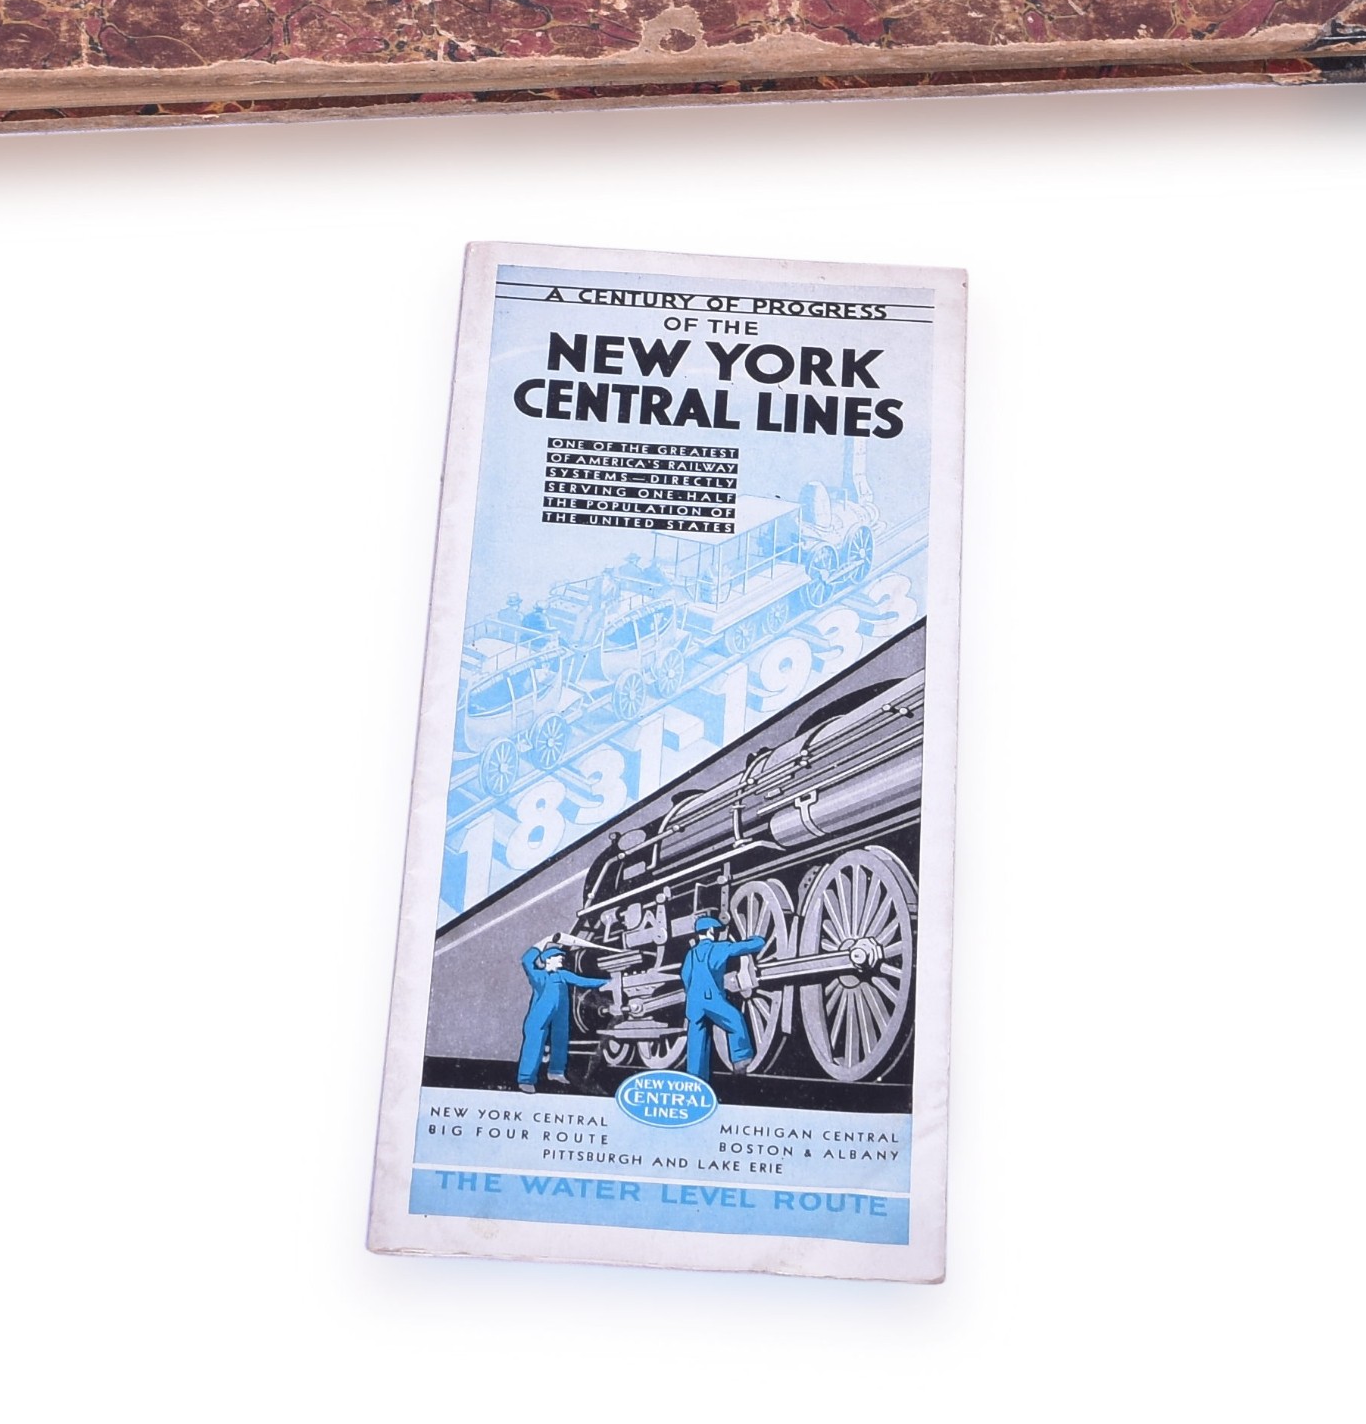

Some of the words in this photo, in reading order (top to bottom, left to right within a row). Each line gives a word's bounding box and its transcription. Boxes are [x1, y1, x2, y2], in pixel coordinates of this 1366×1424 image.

[545, 286, 567, 304] A
[576, 287, 695, 311] CENTURY
[705, 294, 739, 313] OF
[751, 297, 889, 321] PROGRESS
[662, 315, 699, 332] OF
[706, 317, 759, 336] THE
[546, 330, 692, 378] NEW
[703, 340, 885, 389] YORK
[512, 377, 741, 430] CENTRAL
[755, 390, 904, 439] LINES
[550, 437, 586, 451] ONE
[592, 440, 614, 452] OF
[619, 441, 649, 454] THE
[655, 443, 737, 460] GREATEST
[549, 452, 571, 465] OF
[571, 453, 661, 470] AMERICA'S
[666, 459, 736, 474] RAILWAY
[546, 482, 628, 498] SERVING
[544, 496, 579, 509] THE
[584, 498, 703, 517] POPULATION
[709, 506, 734, 518] OF
[543, 511, 578, 524] THE
[587, 514, 655, 529] UNITED
[664, 518, 732, 533] STATES
[634, 1078, 665, 1090] NEW
[667, 1080, 702, 1093] YORK
[623, 1087, 712, 1108] CENTRAL
[429, 1105, 469, 1118] NEW
[476, 1108, 522, 1122] YORK
[532, 1111, 608, 1127] CENTRAL
[644, 1106, 689, 1120] LINES
[427, 1123, 463, 1137] BIG
[475, 1125, 529, 1140] FOUR
[541, 1129, 608, 1145] ROUTE
[718, 1123, 812, 1140] MICHIGAN
[821, 1129, 899, 1144] CENTRAL
[542, 1147, 642, 1165] PITTSBURGH
[651, 1156, 688, 1169] AND
[696, 1158, 740, 1172] LAKE
[748, 1161, 783, 1175] ERIE
[718, 1140, 793, 1157] BOSTON
[802, 1147, 812, 1158] &
[822, 1148, 899, 1161] ALBANY
[434, 1169, 502, 1193] THE
[519, 1174, 641, 1202] WATER
[660, 1183, 756, 1209] LEVEL
[772, 1189, 888, 1217] ROUTE
